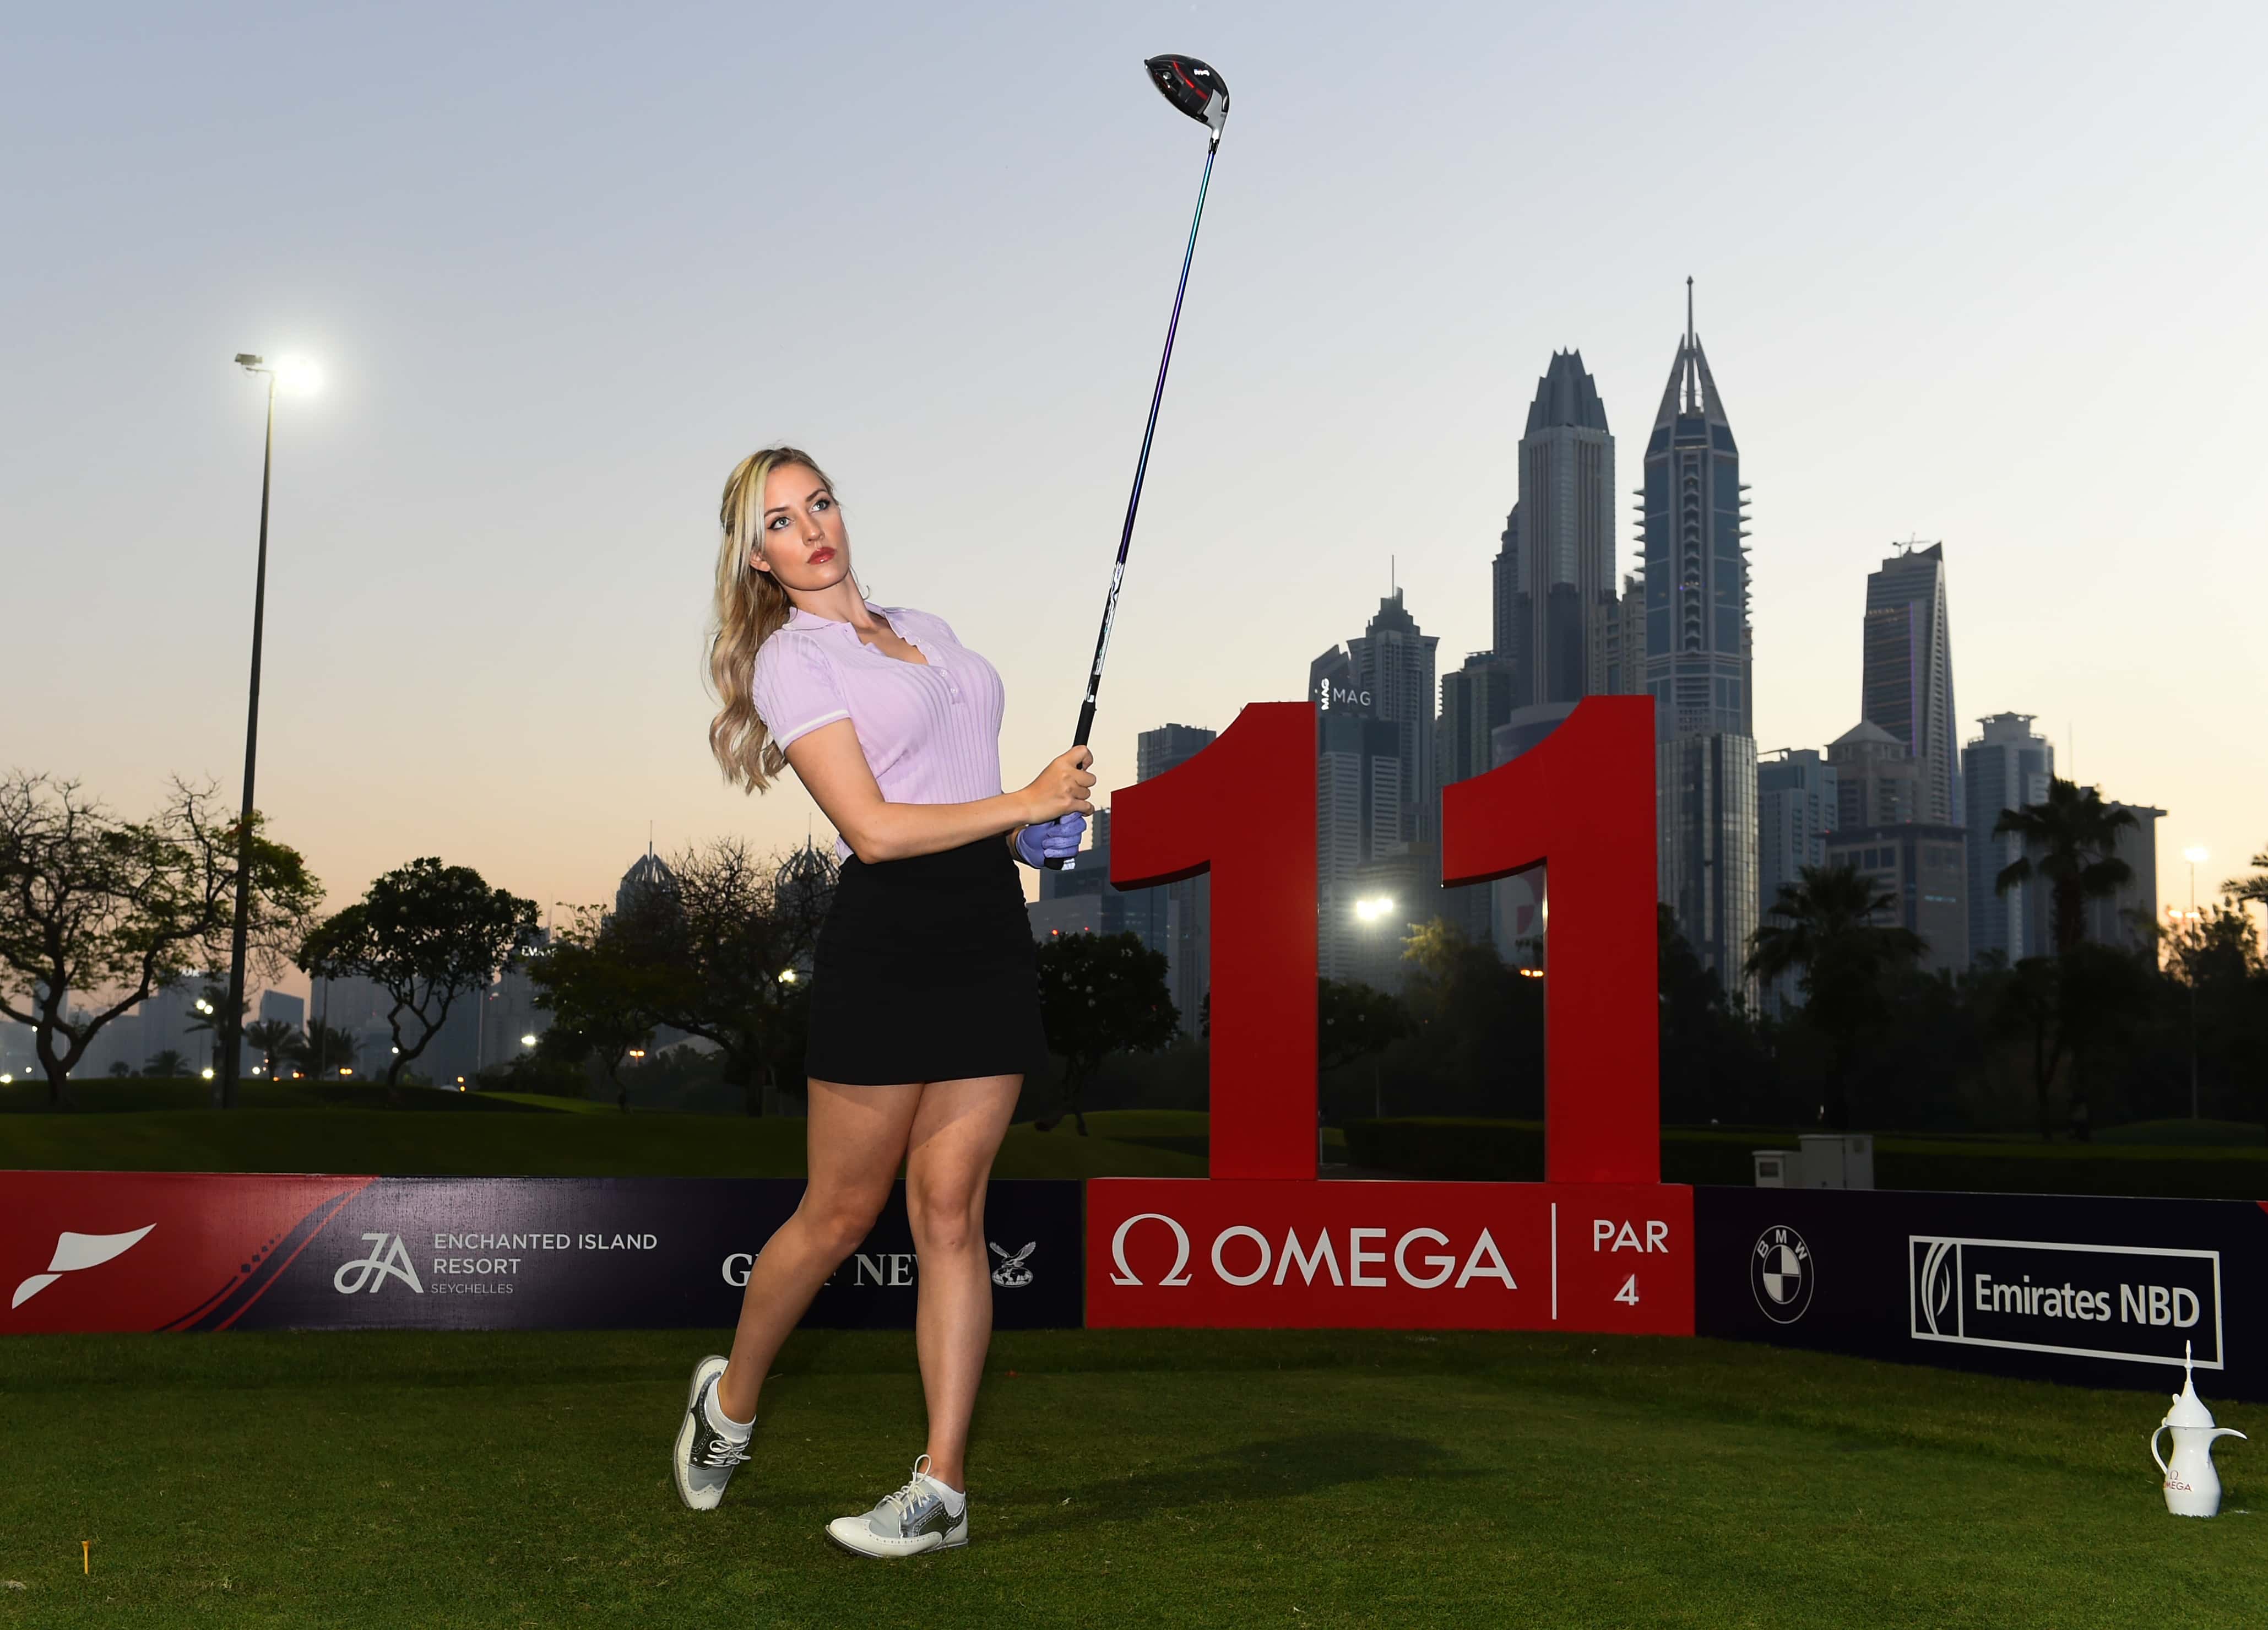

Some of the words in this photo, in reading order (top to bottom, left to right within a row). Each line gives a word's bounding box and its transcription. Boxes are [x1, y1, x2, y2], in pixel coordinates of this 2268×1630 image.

[1333, 687, 1371, 706] MAG
[434, 1233, 571, 1250] ENCHANTED
[579, 1234, 658, 1250] ISLAND
[1593, 1220, 1669, 1254] PAR
[1757, 1229, 1808, 1261] BMW
[334, 1233, 424, 1294] JA
[433, 1258, 522, 1275] RESORT
[1211, 1225, 1518, 1290] OMEGA
[431, 1284, 514, 1295] SEYCHELLES
[1614, 1274, 1640, 1306] 4
[1976, 1274, 2112, 1322] Emirates
[2120, 1284, 2201, 1328] NBD
